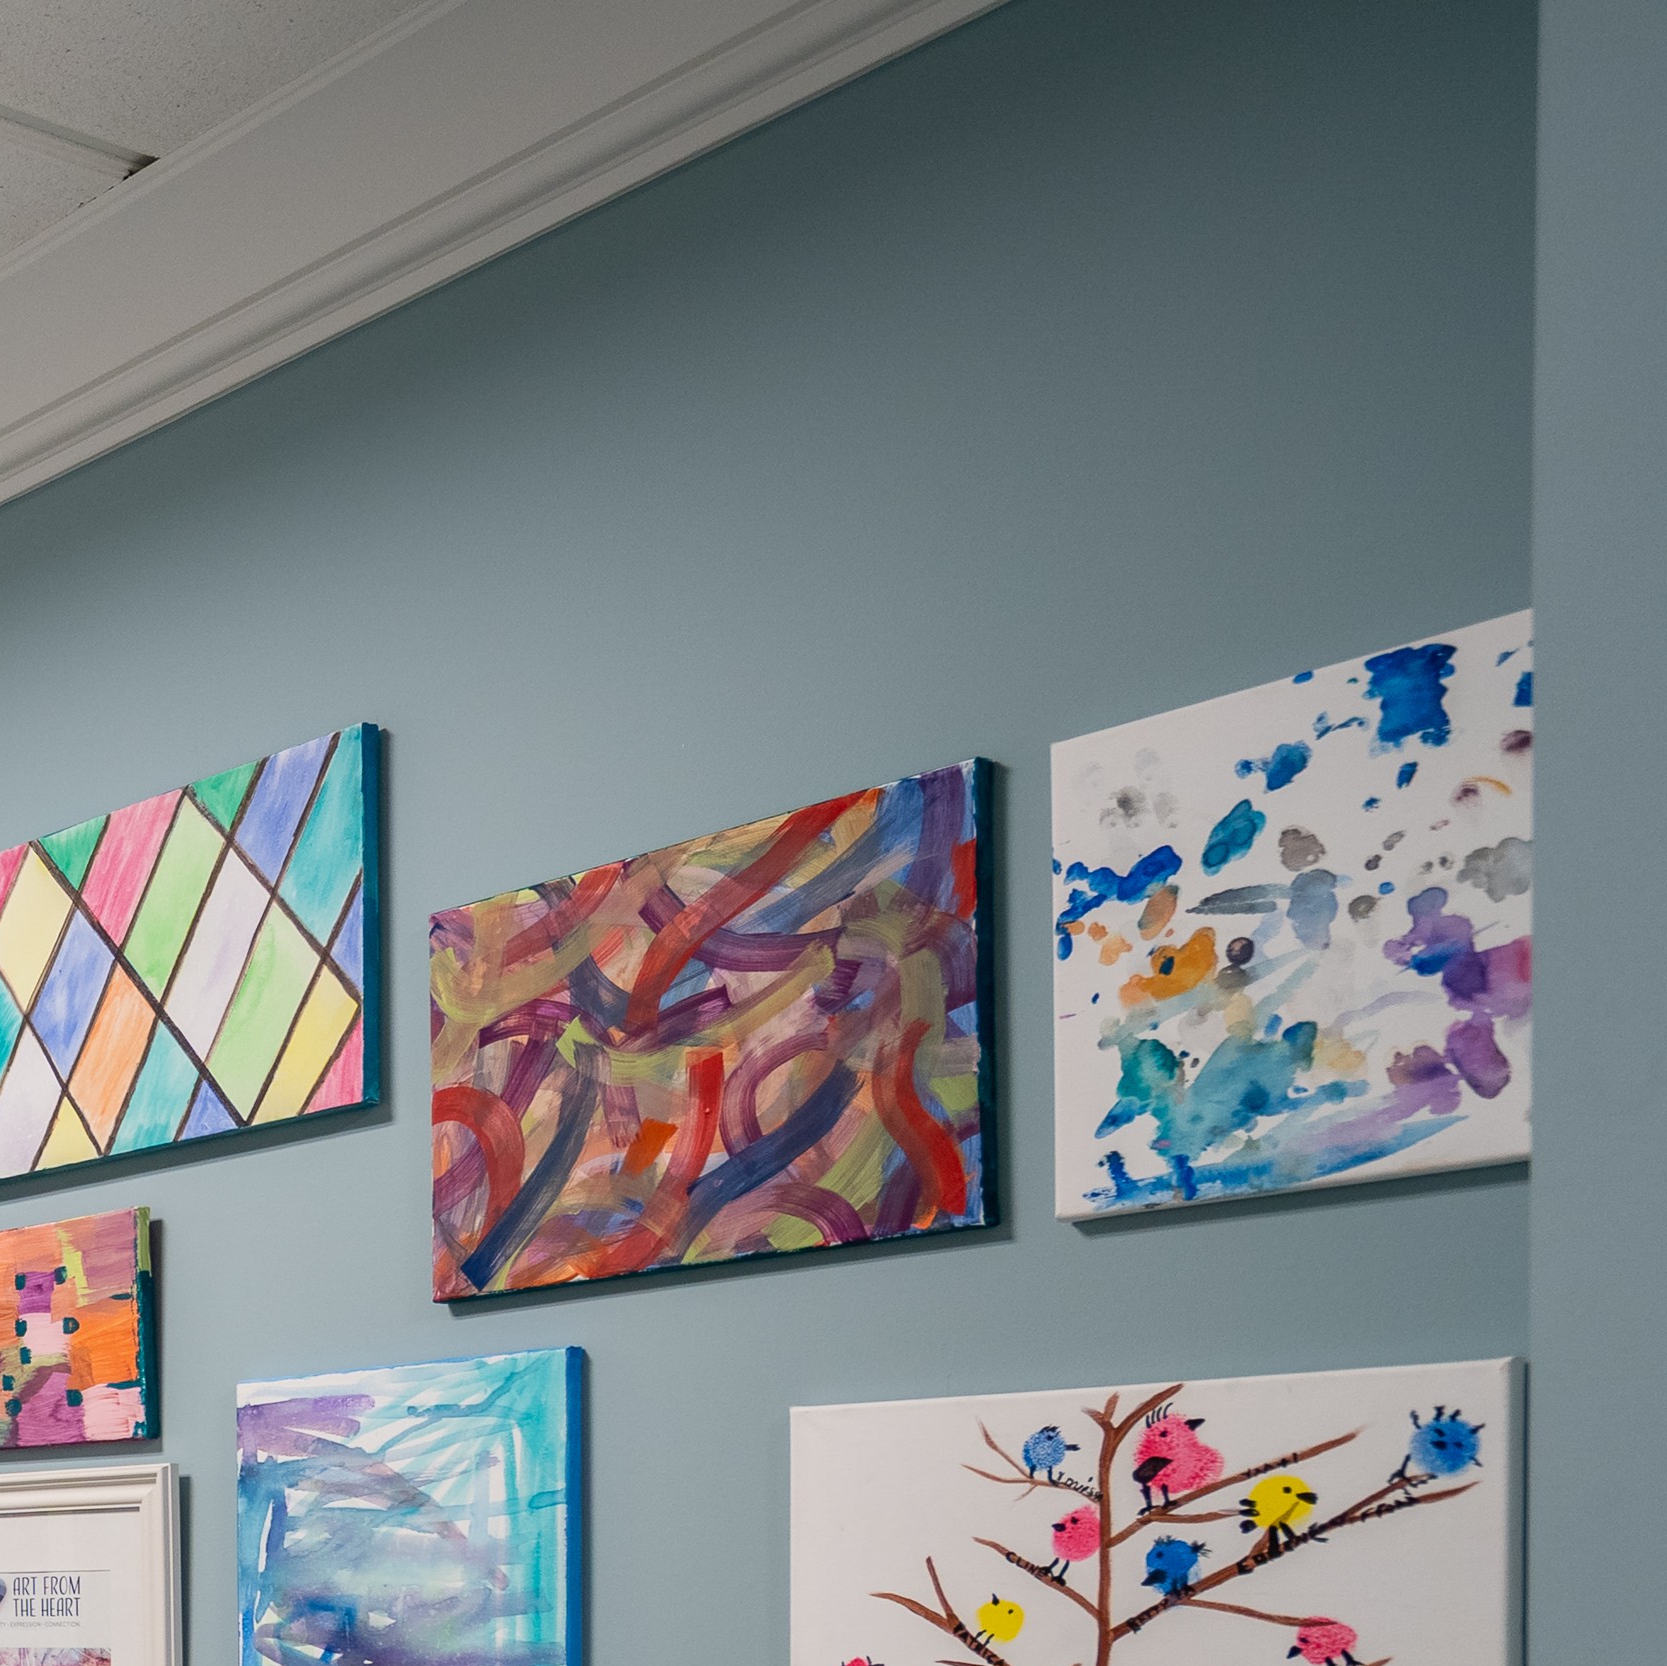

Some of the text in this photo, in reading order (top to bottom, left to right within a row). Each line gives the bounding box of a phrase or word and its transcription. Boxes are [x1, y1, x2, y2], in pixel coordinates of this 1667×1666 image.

[13, 1575, 81, 1596] ART FROM
[13, 1597, 81, 1617] THE HEART
[45, 1620, 81, 1628] CONNECTION
